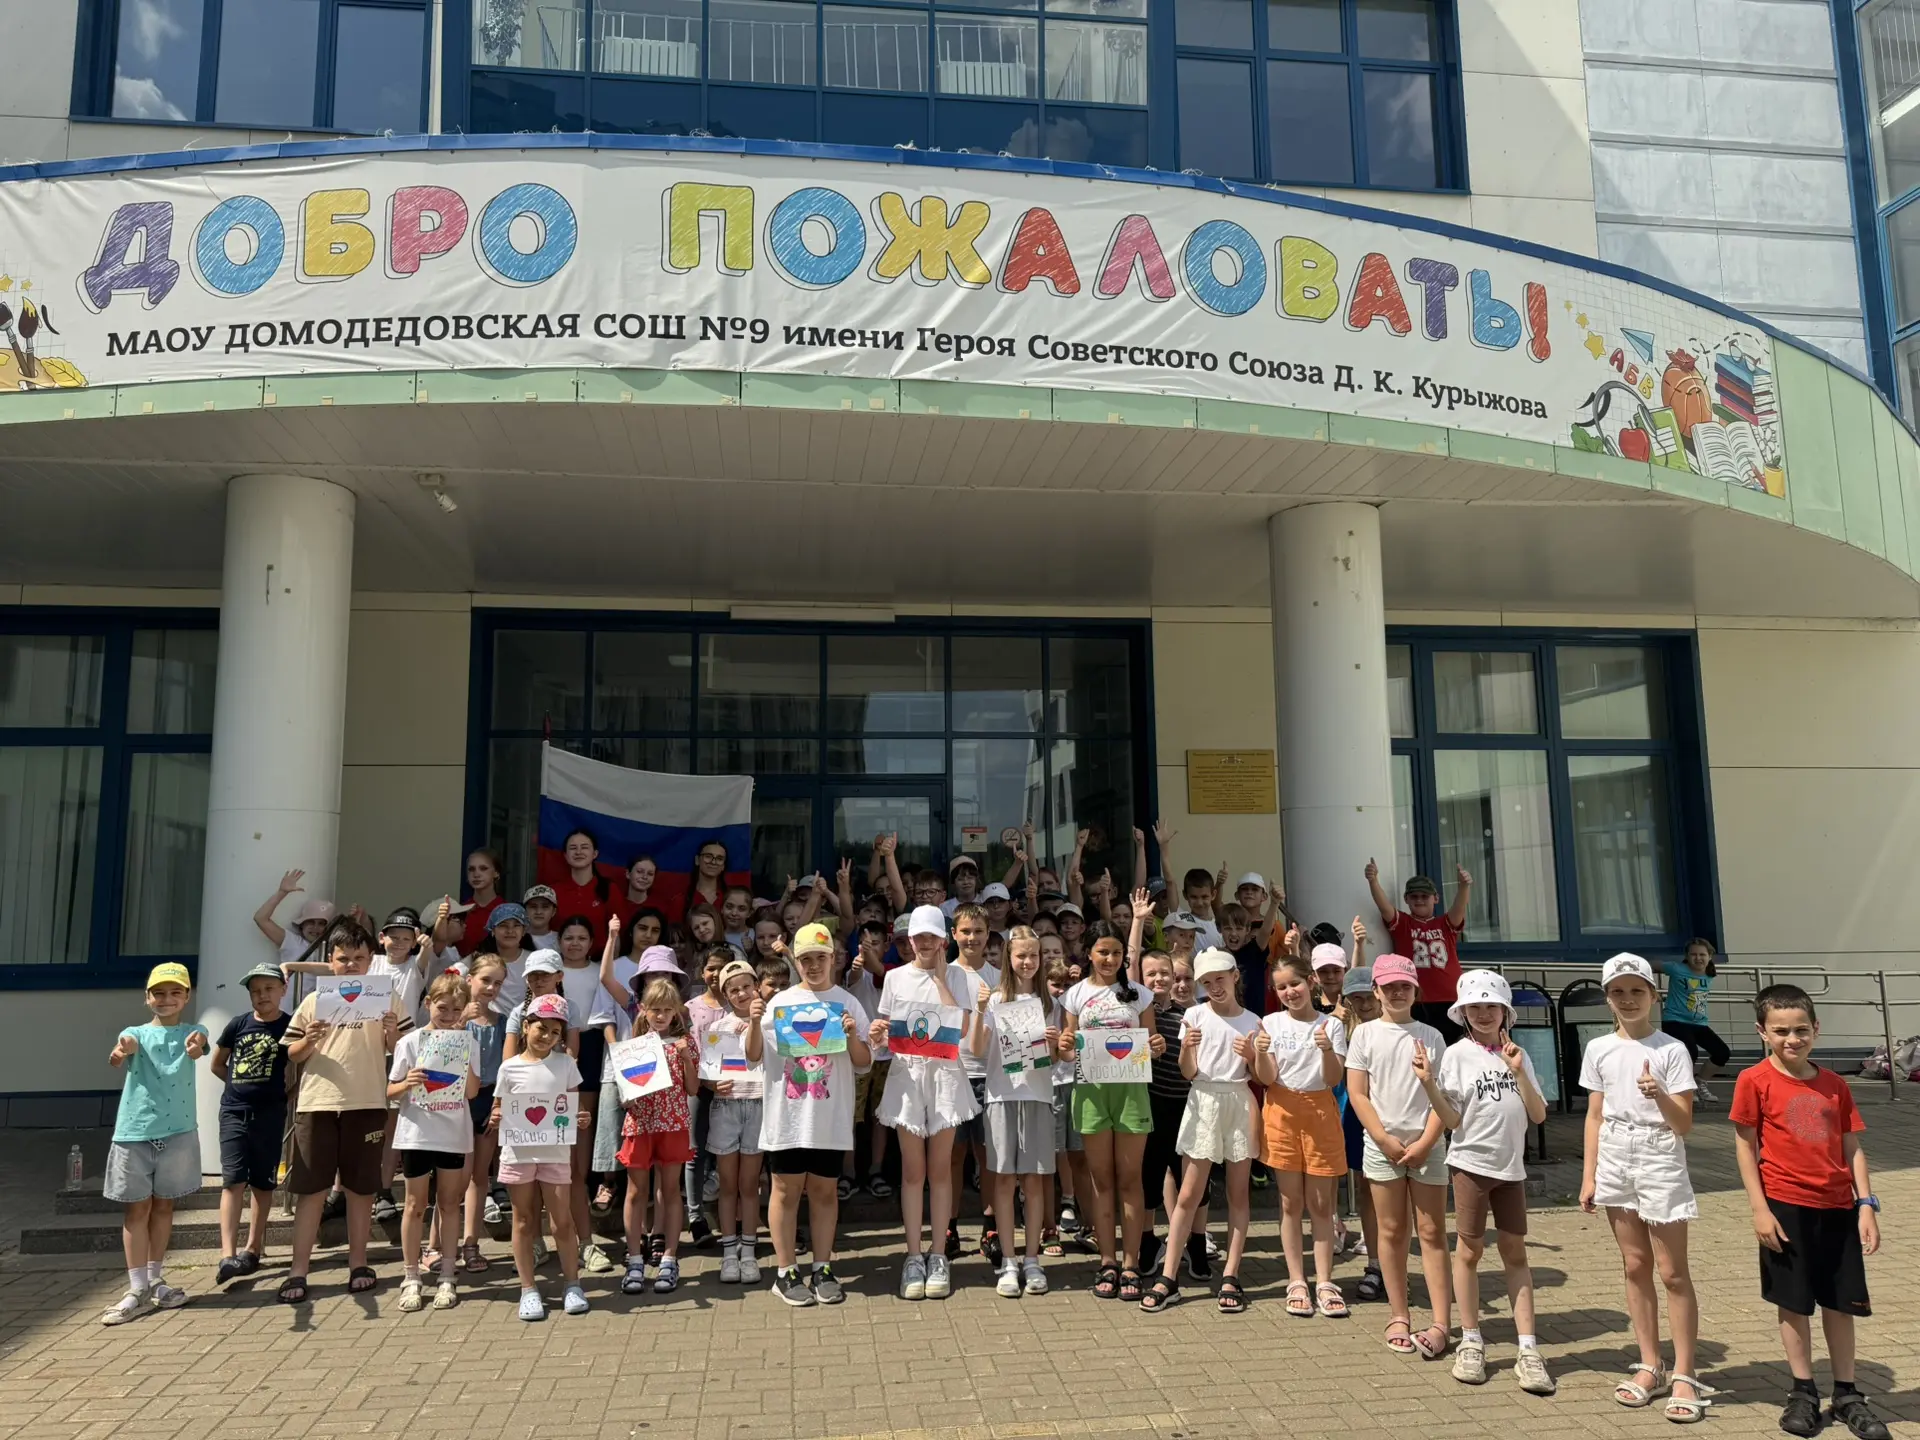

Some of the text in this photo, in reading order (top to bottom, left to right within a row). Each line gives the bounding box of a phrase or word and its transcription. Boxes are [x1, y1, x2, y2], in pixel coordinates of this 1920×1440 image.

[76, 181, 1552, 363] ДОБРО ПОЖАЛОВАТЬ!
[106, 313, 1548, 419] МАОУ ДОМОДЕДОВСКАЯ СОШ №9 имени Героя Советского Союза Д. К. Курыжова
[1086, 1038, 1097, 1060] Я
